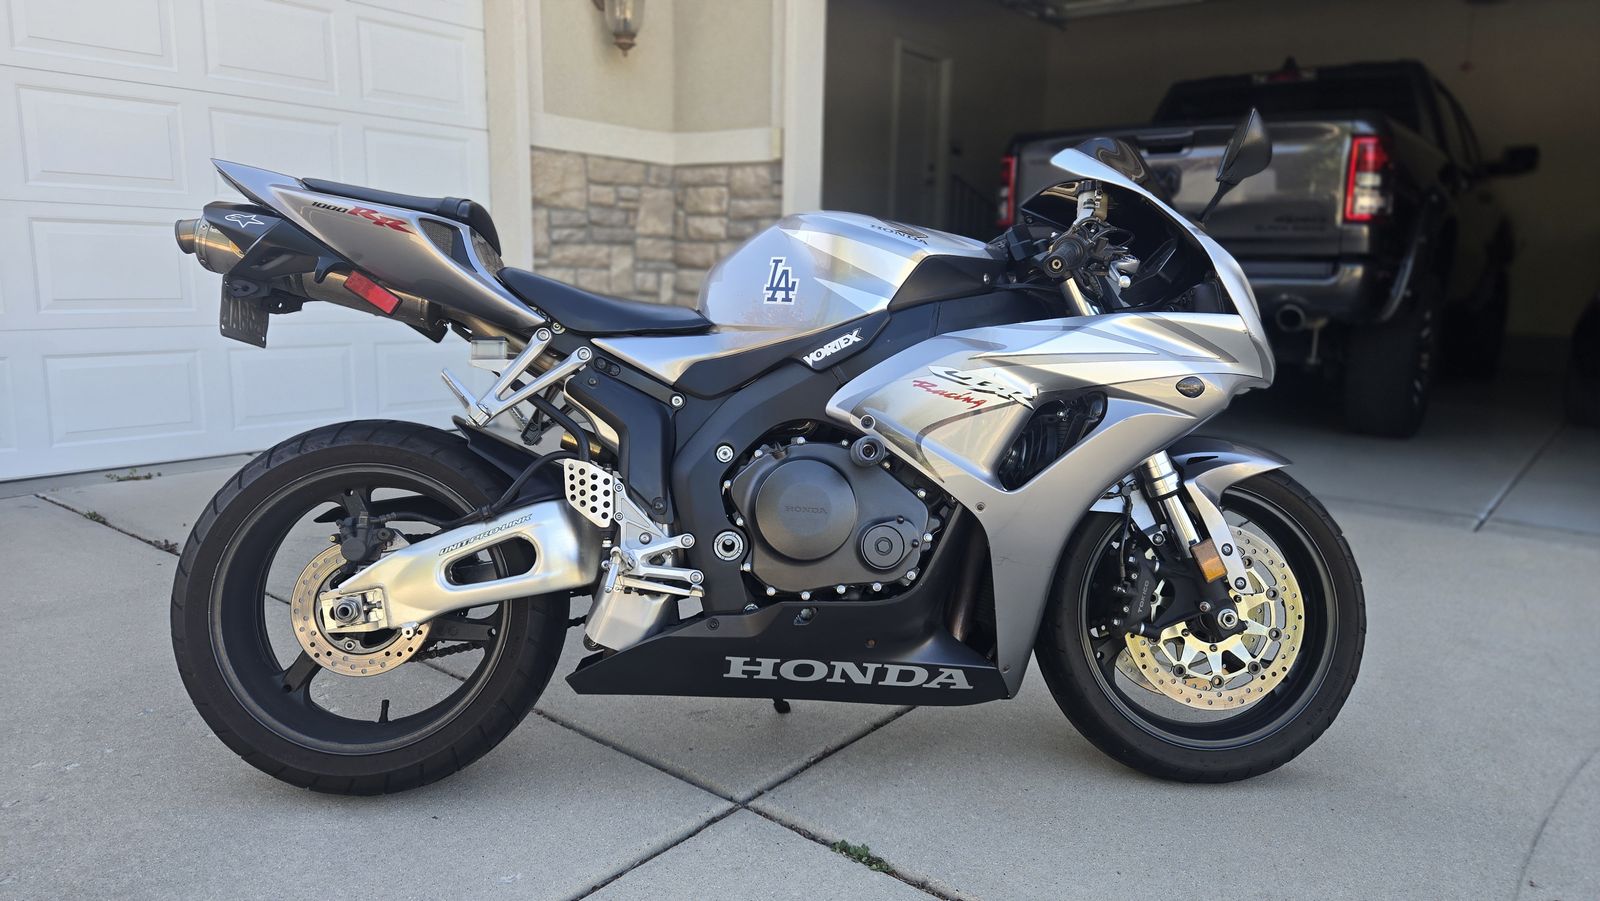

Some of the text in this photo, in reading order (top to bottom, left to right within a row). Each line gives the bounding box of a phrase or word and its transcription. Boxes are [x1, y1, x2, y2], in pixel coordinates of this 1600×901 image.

[763, 257, 799, 304] LA
[803, 329, 863, 366] VORTEX
[912, 379, 987, 410] Racing
[784, 504, 828, 514] HONDA
[1137, 580, 1150, 614] TOKICO
[723, 656, 974, 689] HONDA
